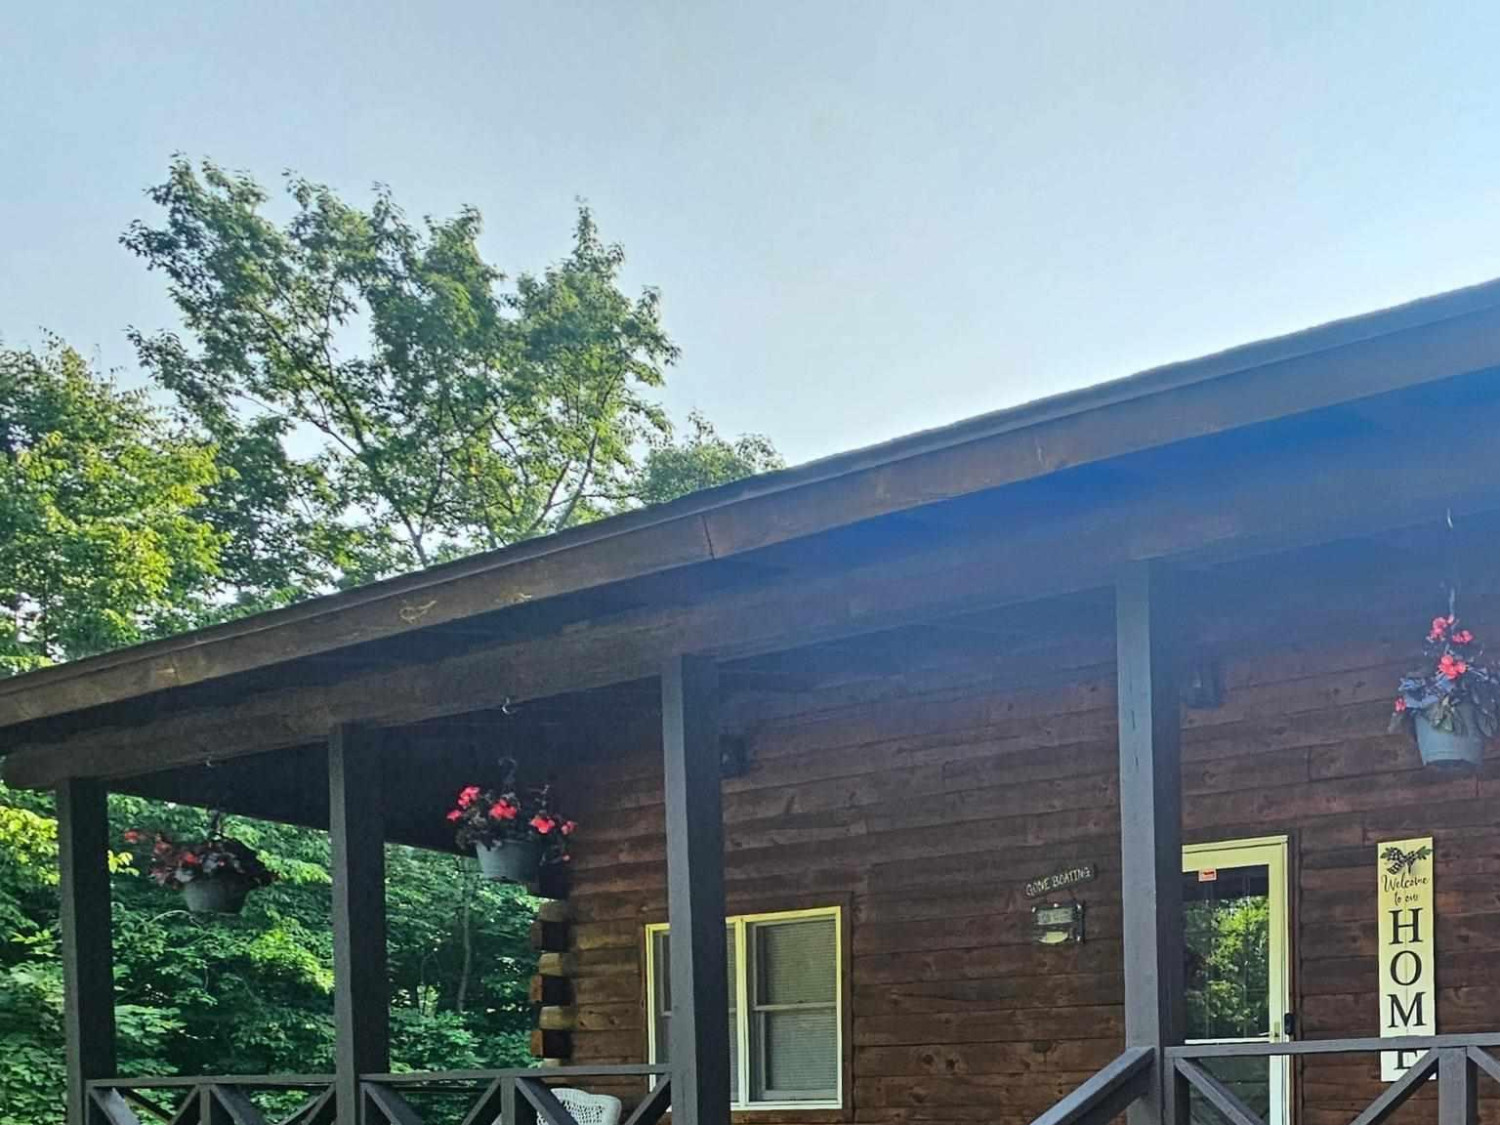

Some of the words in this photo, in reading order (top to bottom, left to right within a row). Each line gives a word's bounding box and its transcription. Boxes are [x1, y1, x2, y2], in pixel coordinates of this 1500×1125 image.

[1025, 878, 1050, 896] GONE
[1052, 867, 1090, 887] BOATING
[1381, 871, 1429, 893] Welcome
[1394, 891, 1402, 906] to
